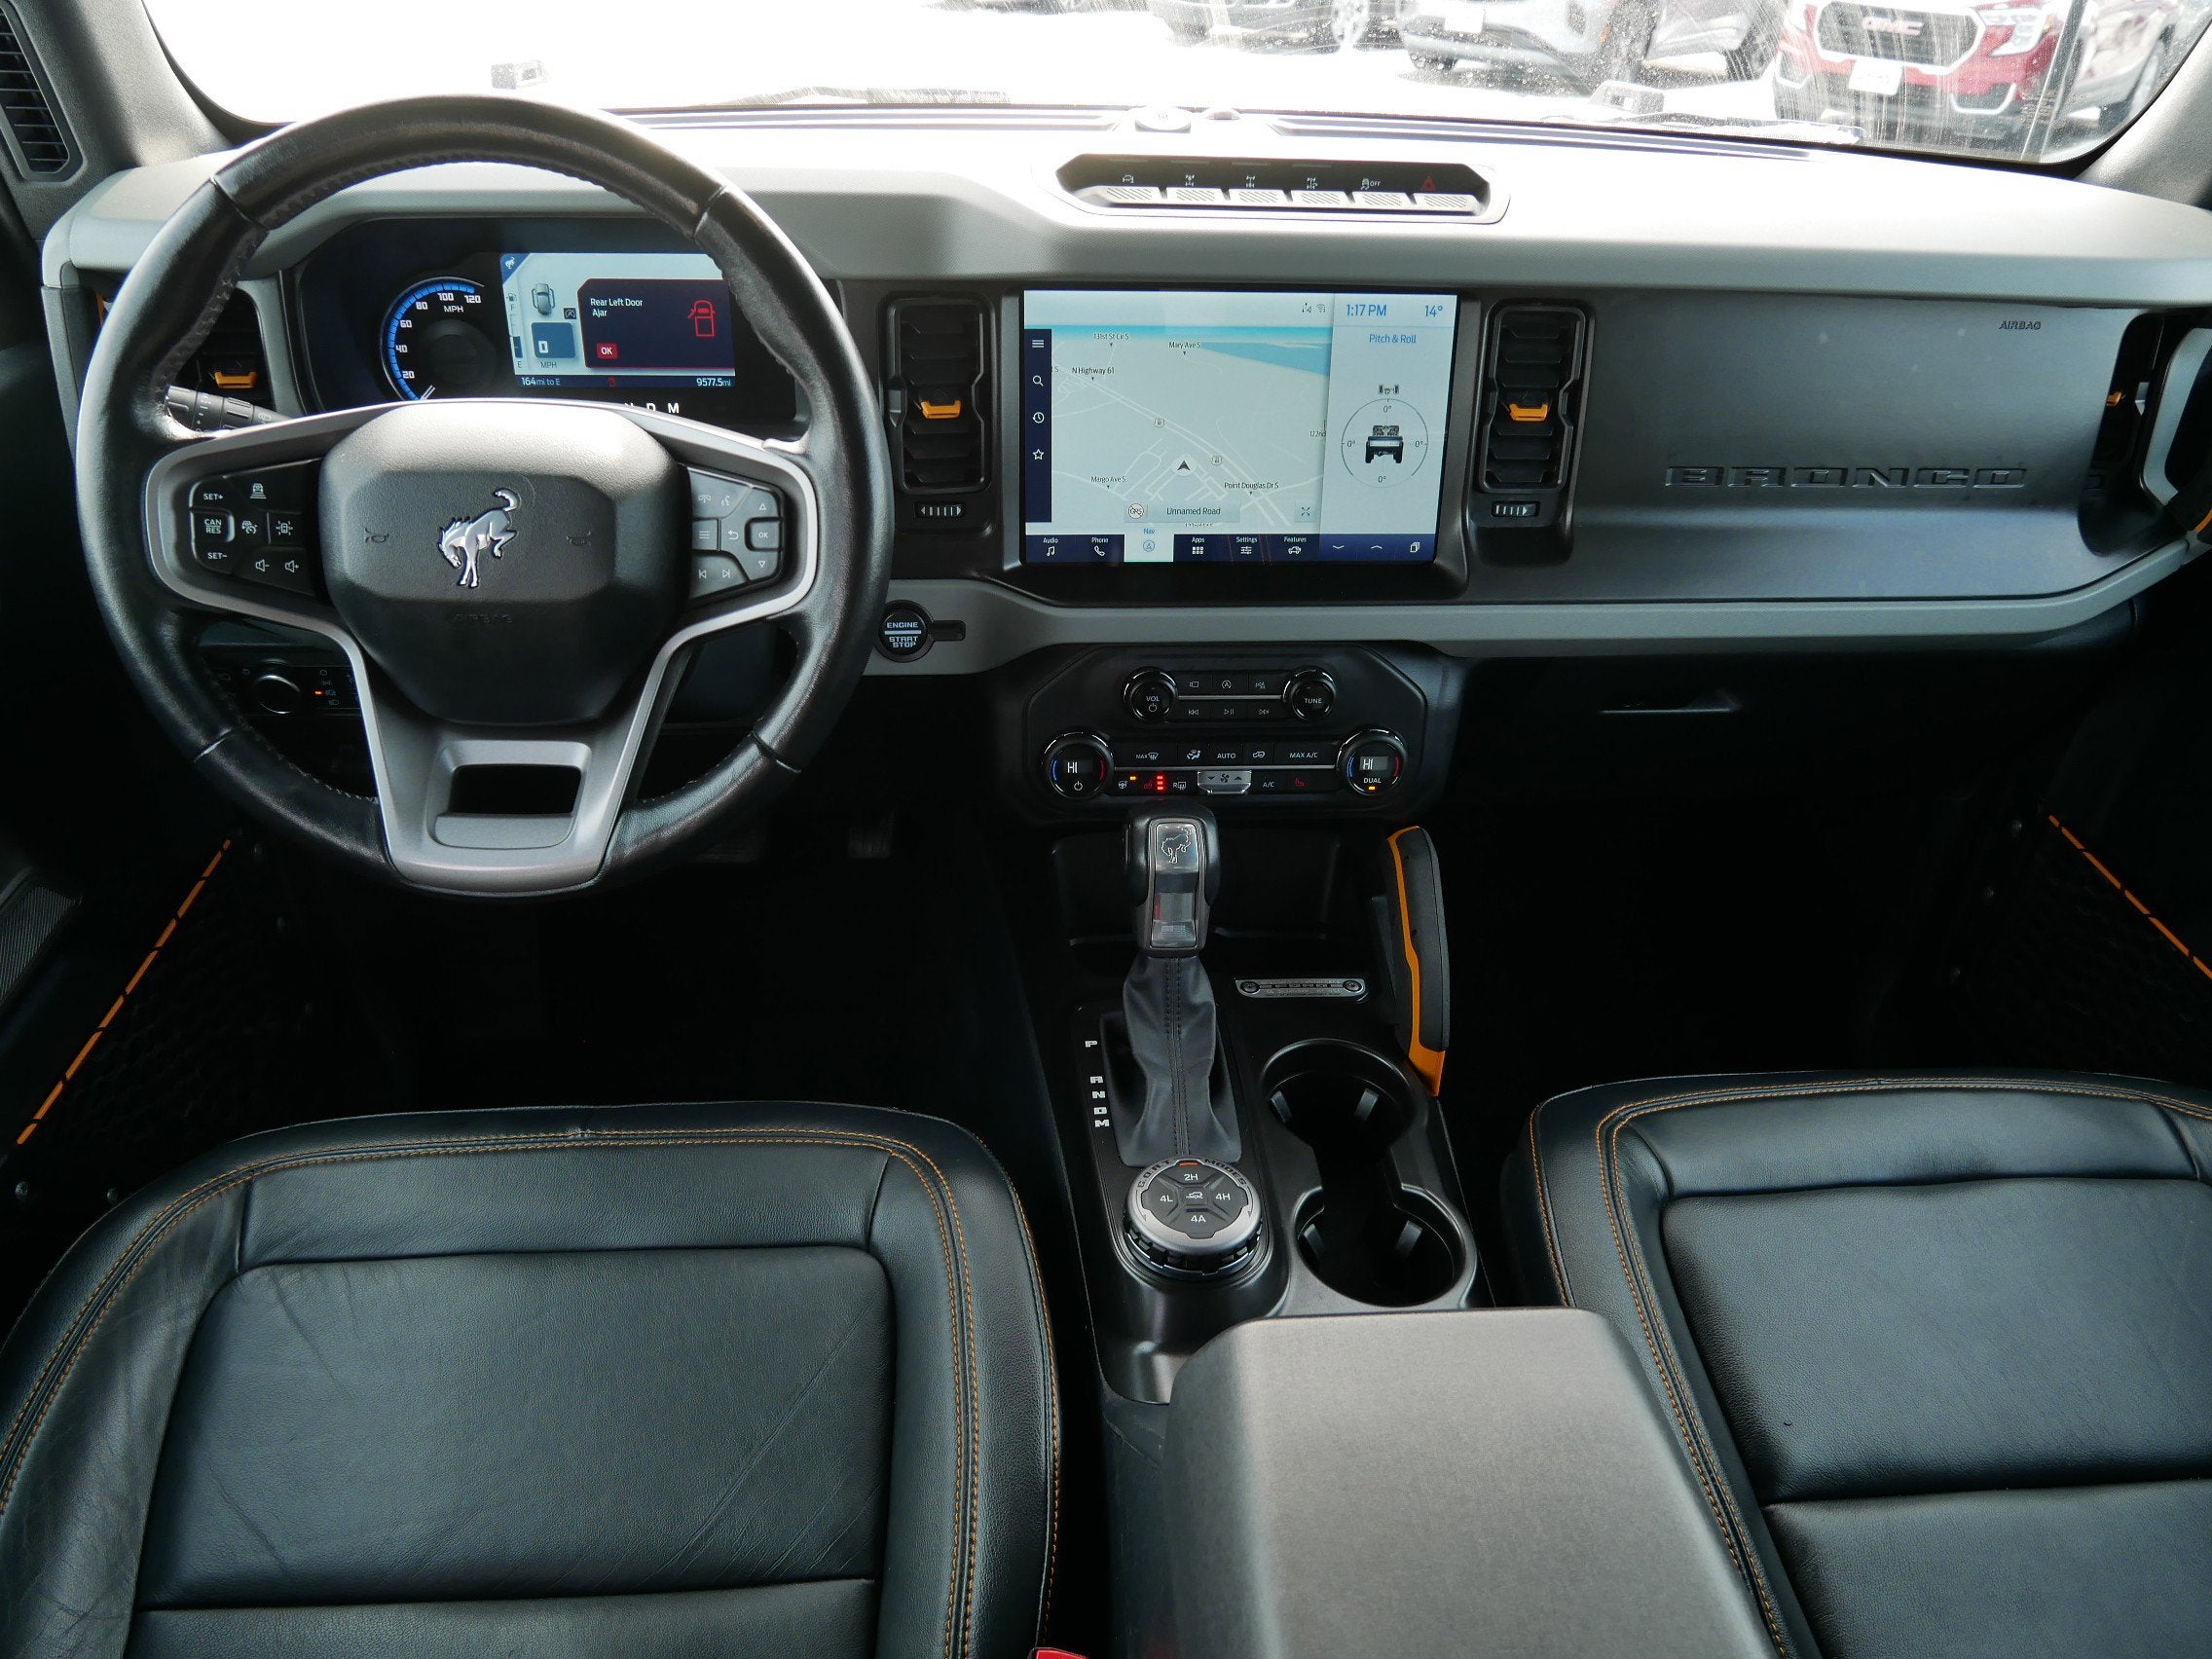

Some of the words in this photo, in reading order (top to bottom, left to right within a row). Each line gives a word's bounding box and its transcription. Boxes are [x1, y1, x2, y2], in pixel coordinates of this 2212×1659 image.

[464, 295, 481, 304] 120
[444, 305, 463, 313] MPH
[592, 309, 608, 317] Ajar
[1346, 304, 1365, 316] 1:17
[1369, 305, 1387, 316] PM
[1425, 305, 1444, 317] 14°
[1999, 320, 2042, 330] AIRBAG
[1369, 334, 1390, 343] Pitch
[1401, 335, 1417, 344] Roll
[395, 345, 408, 353] 40
[538, 341, 548, 353] 0
[601, 347, 612, 355] OK
[667, 403, 680, 414] M
[1665, 465, 2027, 488] BRONCO
[1241, 482, 1265, 491] Douglas
[1067, 761, 1078, 774] HI
[1363, 758, 1373, 769] HI
[1093, 1106, 1108, 1115] D
[1205, 1159, 1246, 1185] MODES
